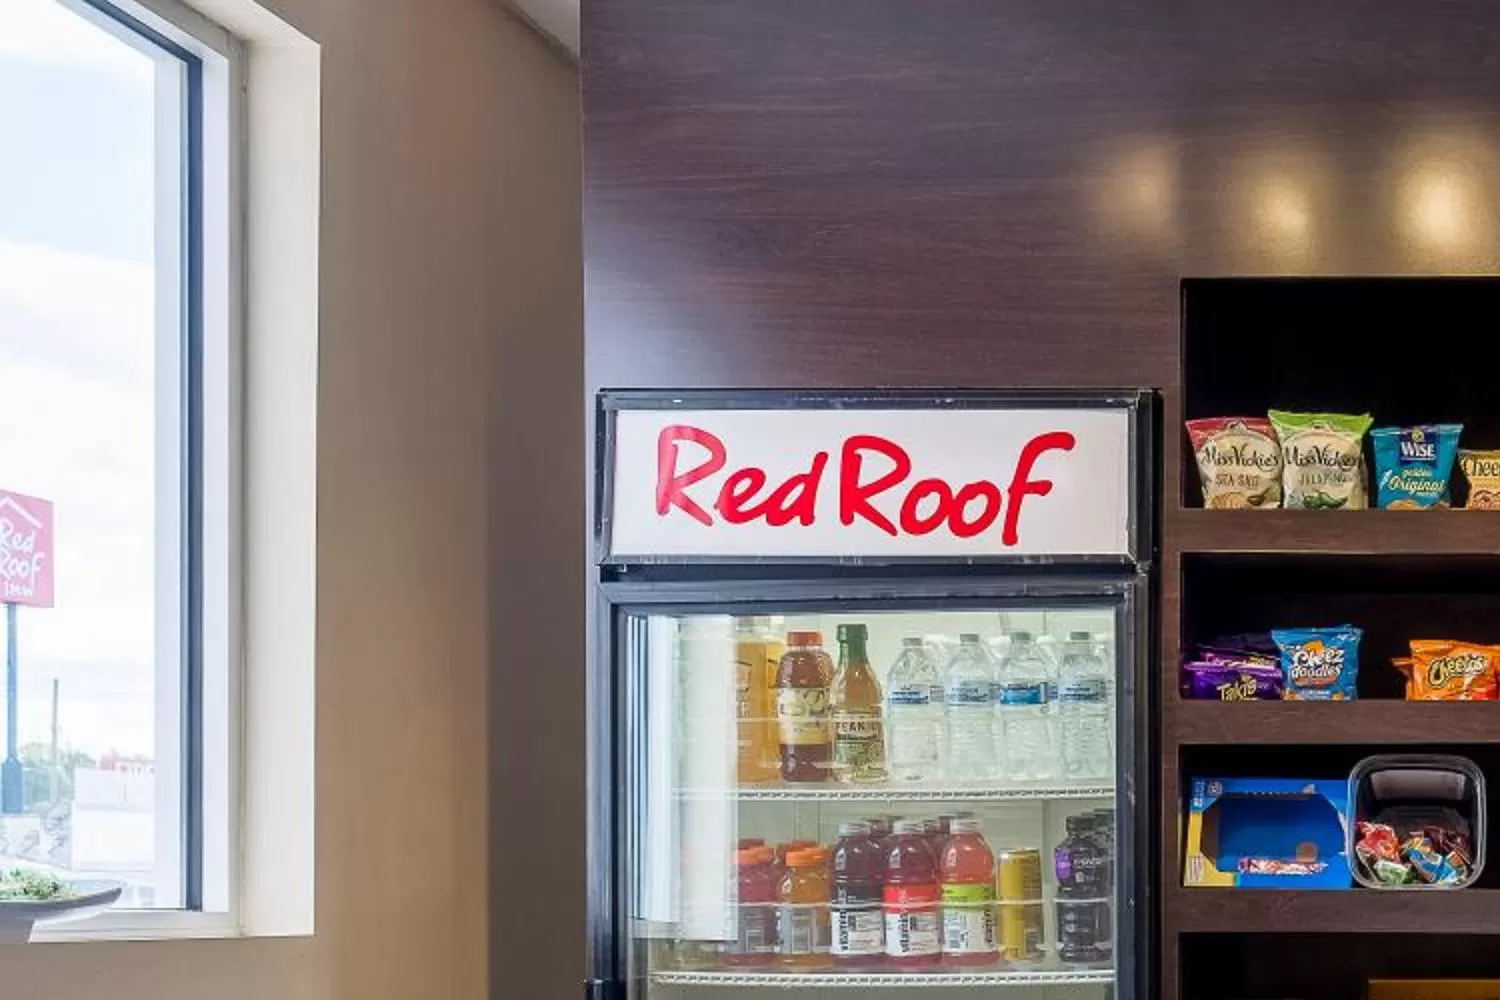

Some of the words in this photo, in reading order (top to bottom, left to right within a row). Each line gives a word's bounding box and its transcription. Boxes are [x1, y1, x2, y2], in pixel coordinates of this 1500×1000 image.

[1388, 475, 1446, 494] Original
[0, 518, 35, 553] Red
[1428, 655, 1486, 688] Cheetos
